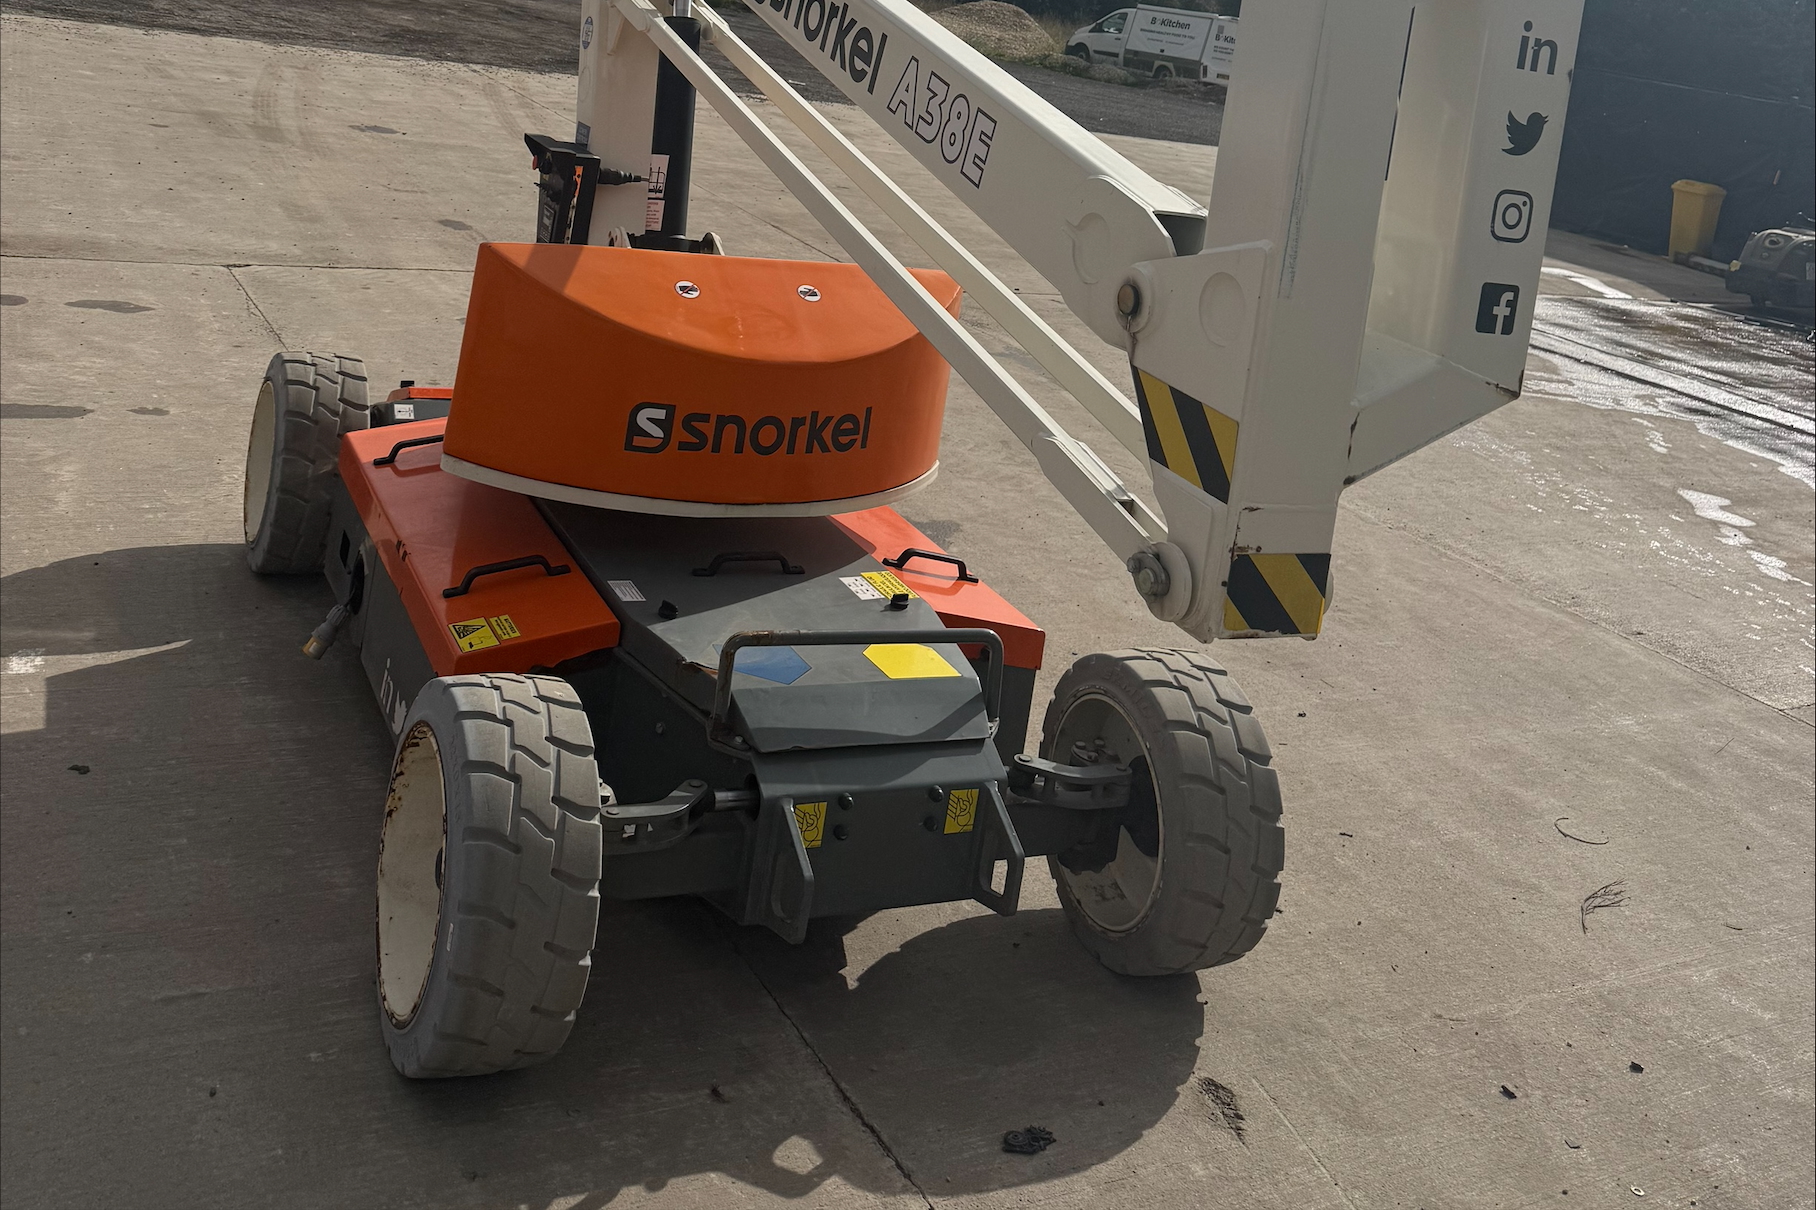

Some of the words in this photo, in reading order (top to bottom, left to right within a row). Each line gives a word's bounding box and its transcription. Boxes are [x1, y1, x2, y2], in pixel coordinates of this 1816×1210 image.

[1516, 20, 1558, 75] in
[886, 55, 998, 190] A38E
[677, 406, 873, 456] snorkel
